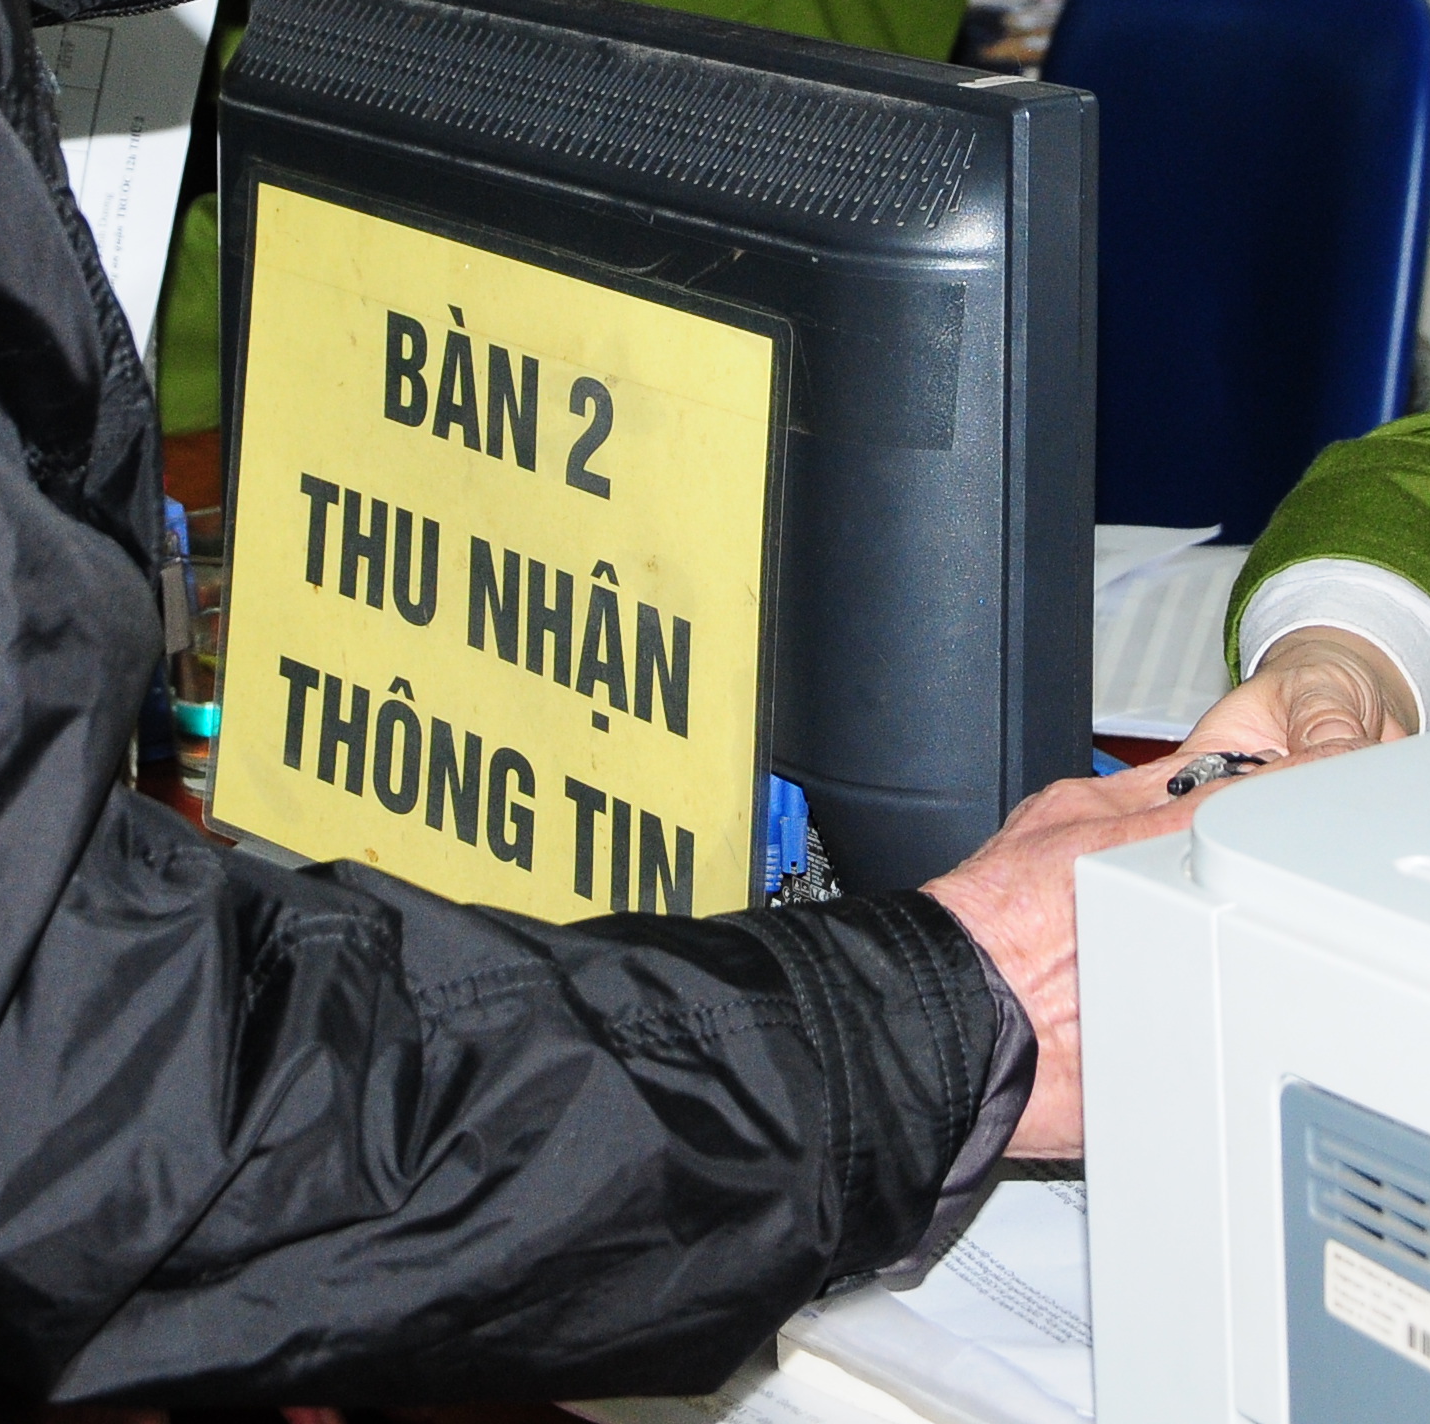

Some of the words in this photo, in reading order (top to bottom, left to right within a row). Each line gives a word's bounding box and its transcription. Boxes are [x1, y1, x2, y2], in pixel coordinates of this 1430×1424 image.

[383, 304, 539, 473] BÀN
[565, 376, 614, 501] 2
[300, 472, 440, 627] THU
[467, 535, 691, 740] NHẬN
[279, 655, 536, 873] THÔNG
[564, 775, 695, 919] TIN
